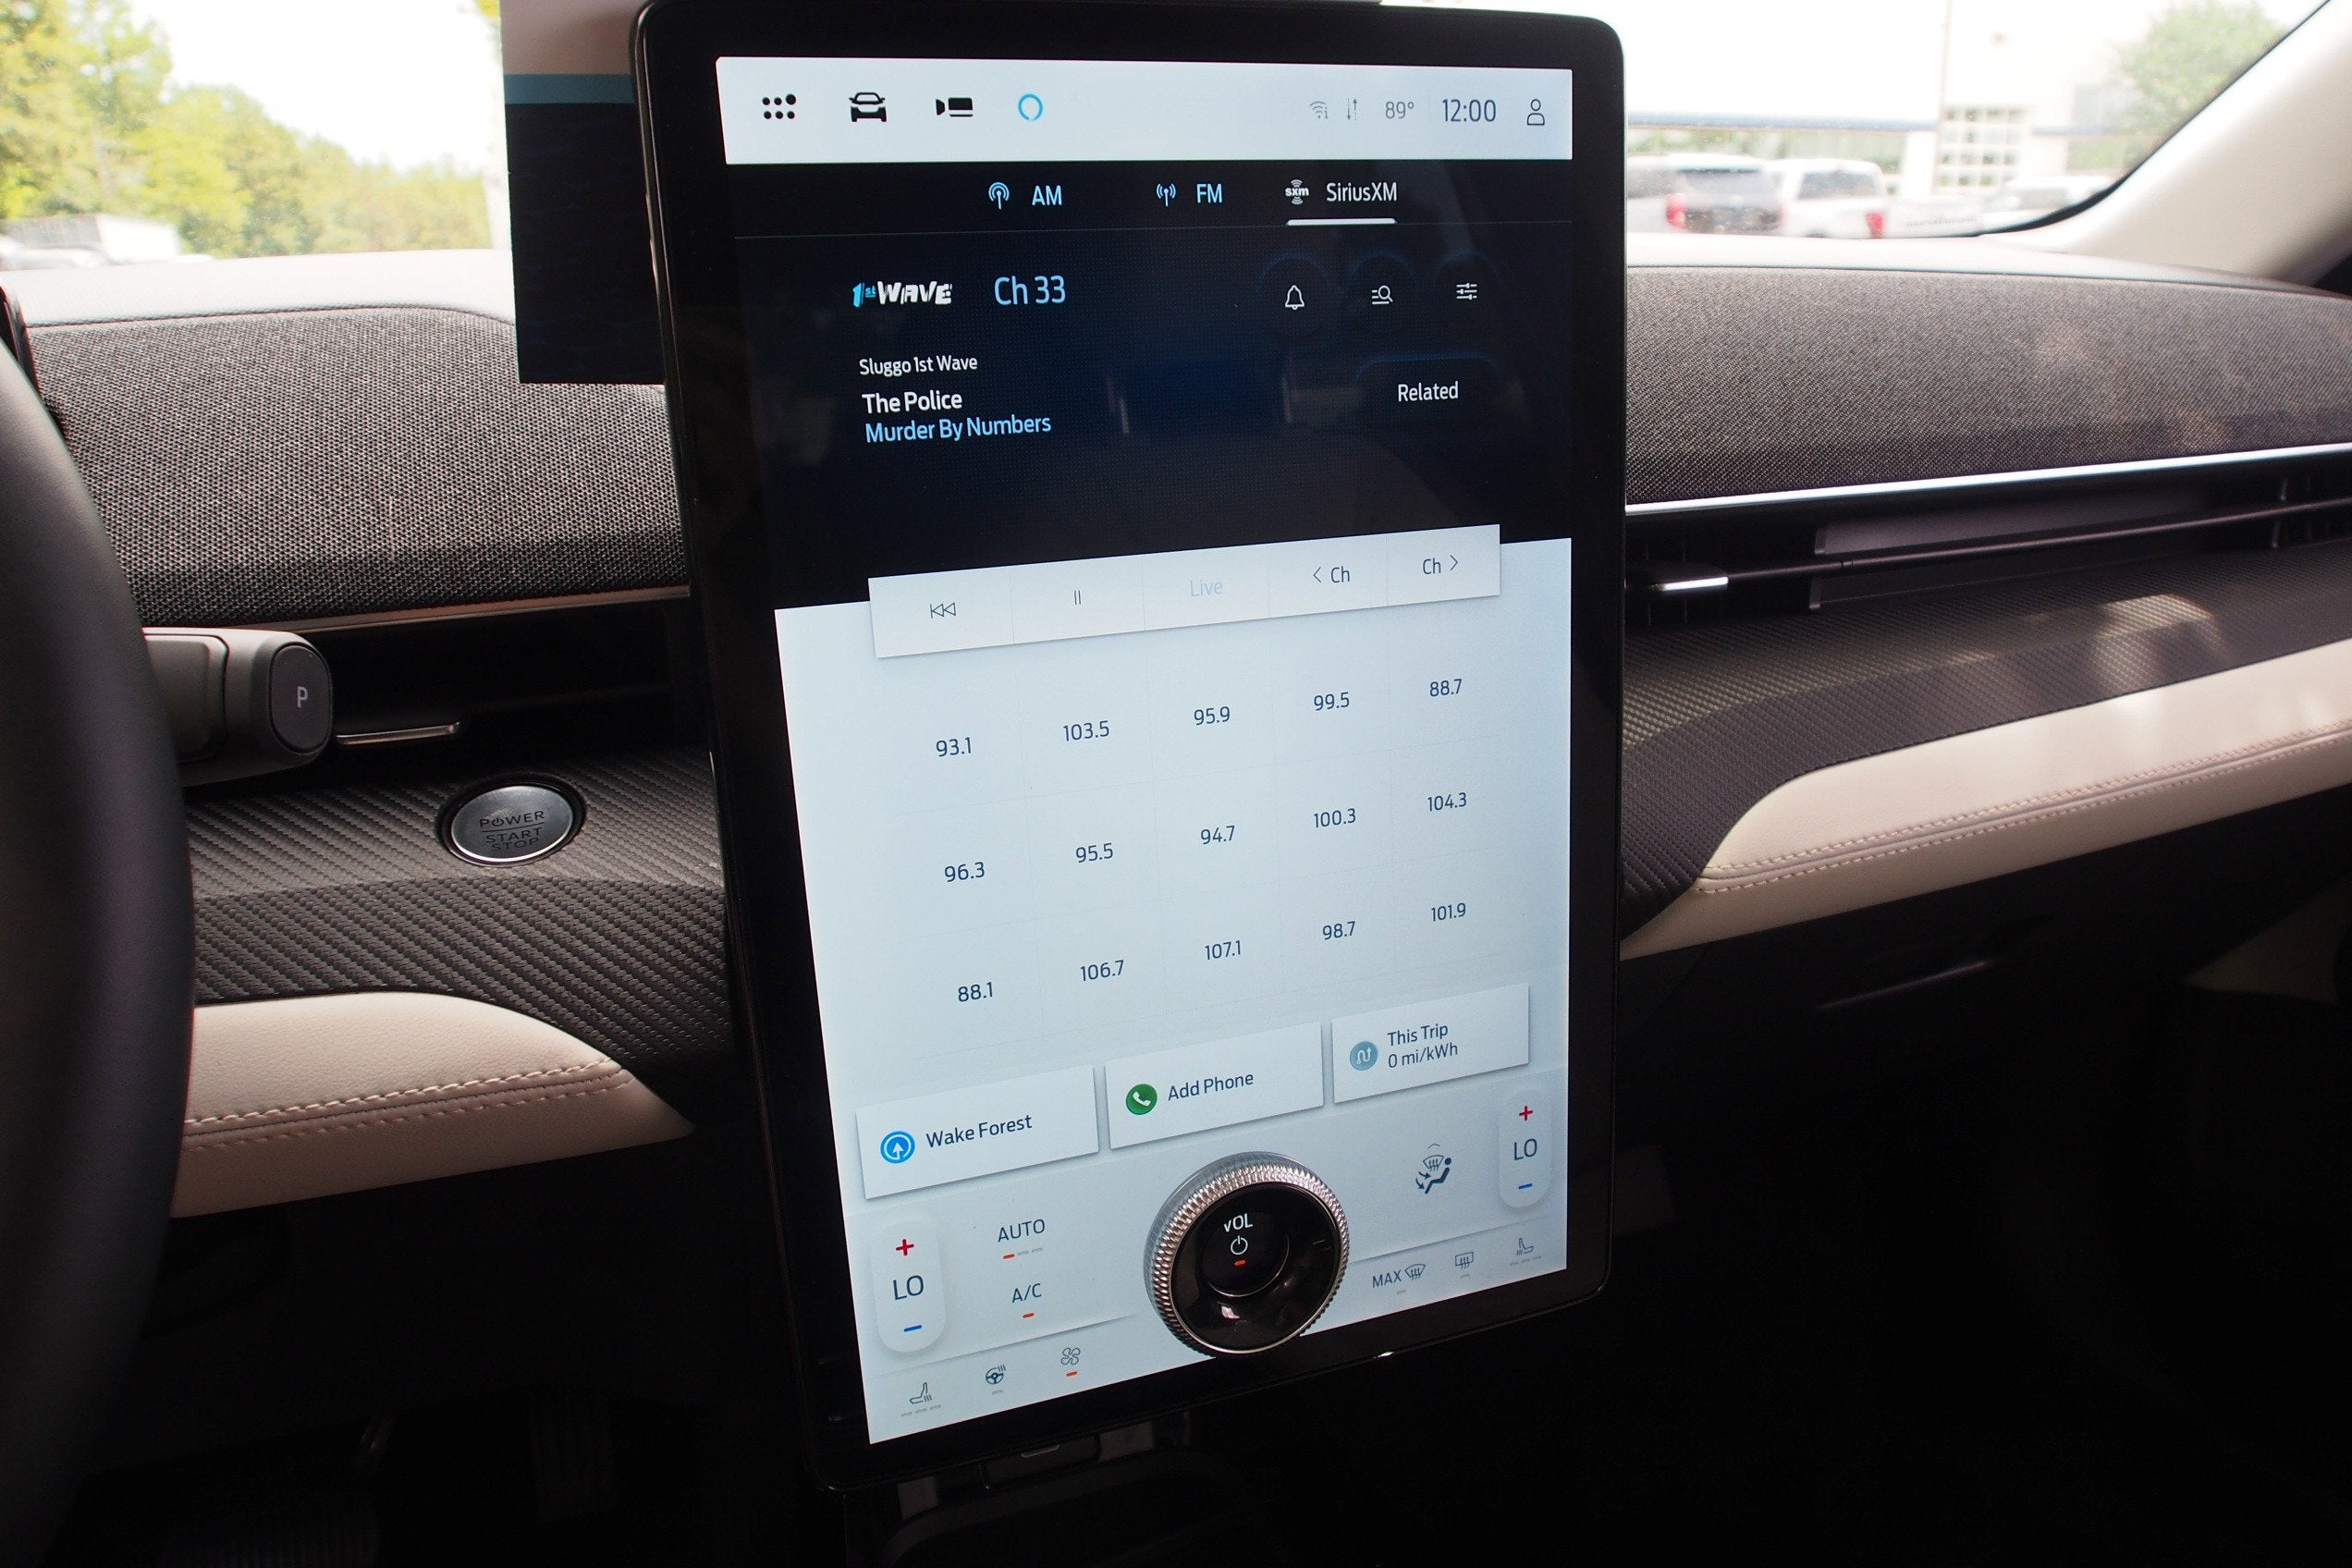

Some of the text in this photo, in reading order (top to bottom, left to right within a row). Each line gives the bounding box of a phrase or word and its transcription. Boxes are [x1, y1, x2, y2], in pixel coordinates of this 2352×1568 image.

[1442, 98, 1497, 123] 12:00
[1031, 185, 1062, 206] AM
[1196, 183, 1223, 203] FM
[1326, 181, 1397, 202] SiriusXM
[994, 275, 1066, 306] Ch 33
[859, 354, 978, 377] Sluggo 1st Wave
[861, 389, 962, 414] The Police
[1398, 380, 1459, 402] Related
[865, 413, 1052, 443] Murder By Numbers
[1330, 565, 1351, 583] Ch
[1422, 557, 1441, 575] Ch
[1189, 578, 1223, 597] Live
[297, 685, 309, 708] P
[1429, 678, 1463, 697] 88.7
[1313, 691, 1350, 712] 99.5
[1194, 705, 1231, 726] 95.9
[1062, 719, 1109, 742] 103.5
[936, 736, 972, 758] 93.1
[1427, 791, 1467, 812] 104.3
[1313, 807, 1356, 828] 100.3
[485, 827, 544, 844] START
[491, 837, 540, 852] STOP
[1200, 825, 1235, 845] 94.7
[1075, 842, 1114, 864] 95.5
[944, 861, 986, 883] 96.3
[1430, 902, 1466, 923] 101.9
[1322, 920, 1356, 941] 98.7
[1205, 939, 1241, 961] 107.1
[1080, 959, 1124, 982] 106.7
[958, 981, 993, 1003] 88.1
[1387, 1023, 1450, 1047] This Trip
[1388, 1041, 1459, 1069] 0 mi/kWh
[1168, 1073, 1254, 1101] Add Phone
[925, 1114, 1033, 1148] Wake Forest
[1513, 1137, 1537, 1161] LO
[998, 1219, 1046, 1243] AUTO
[892, 1274, 925, 1301] LO
[1372, 1269, 1403, 1289] MAX
[1011, 1282, 1042, 1304] A/C
